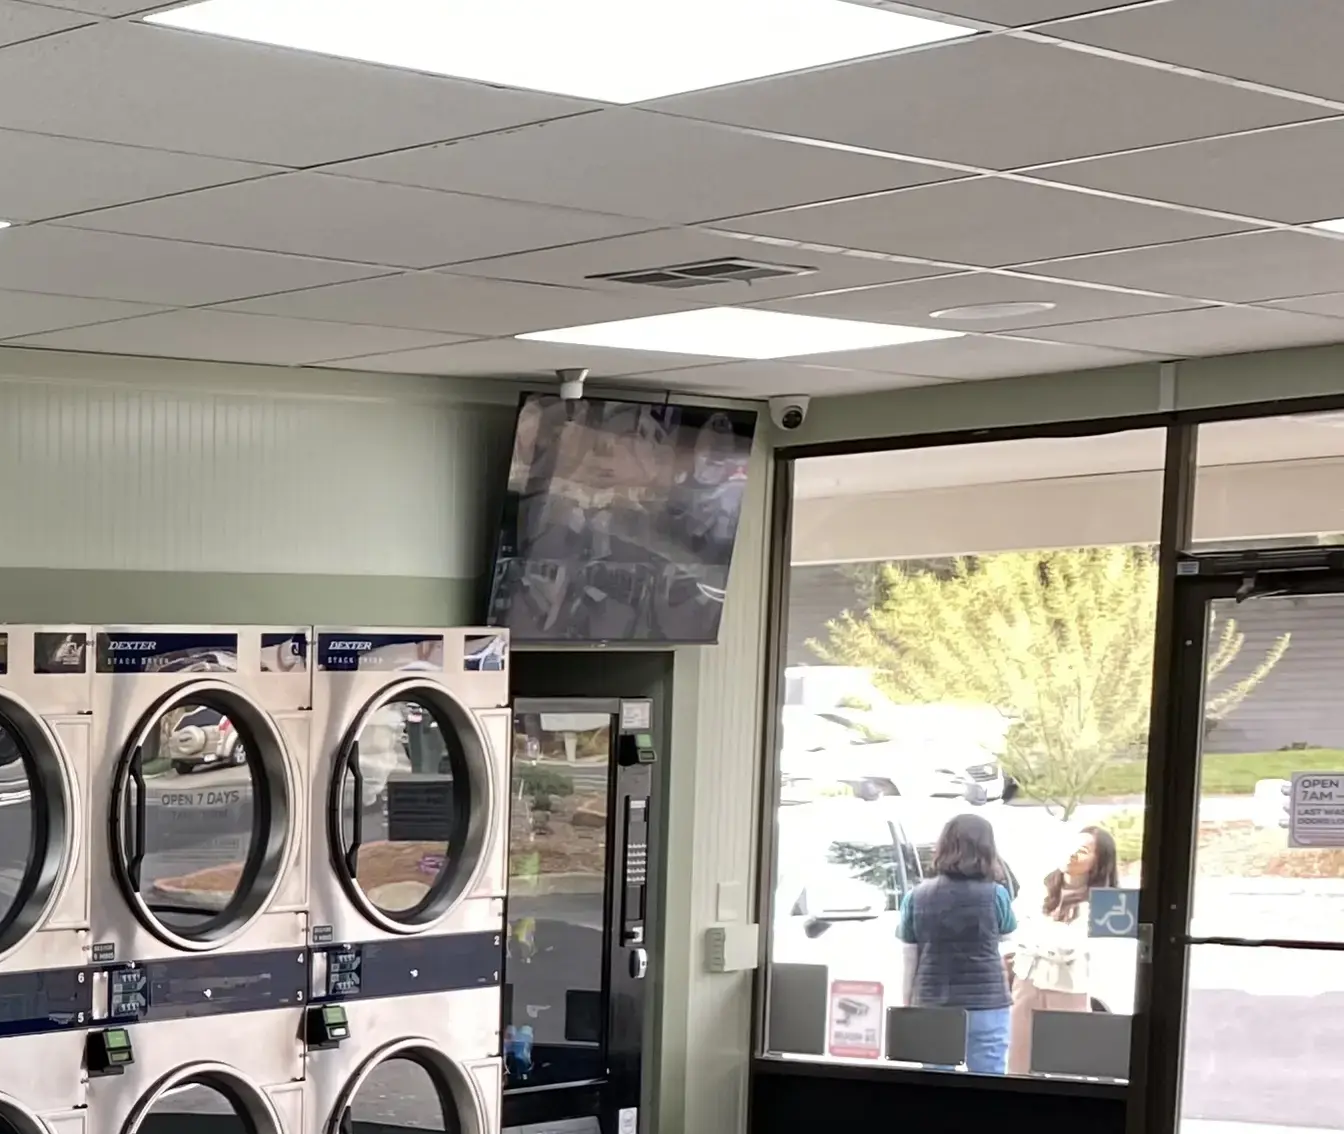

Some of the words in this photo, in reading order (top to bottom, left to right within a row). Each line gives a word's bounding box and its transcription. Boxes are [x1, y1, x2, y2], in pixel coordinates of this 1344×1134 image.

[107, 641, 157, 651] DEXTER
[328, 641, 372, 650] DEXTER
[1301, 779, 1339, 789] OPEN
[161, 793, 193, 805] OPEN
[196, 793, 204, 805] 7
[206, 790, 240, 805] DAYS
[1301, 791, 1333, 801] 7AM
[494, 935, 500, 946] 2
[297, 953, 304, 963] 4
[78, 972, 85, 983] 6
[493, 970, 498, 981] 1
[297, 991, 303, 1001] 3
[77, 1012, 85, 1023] 5
